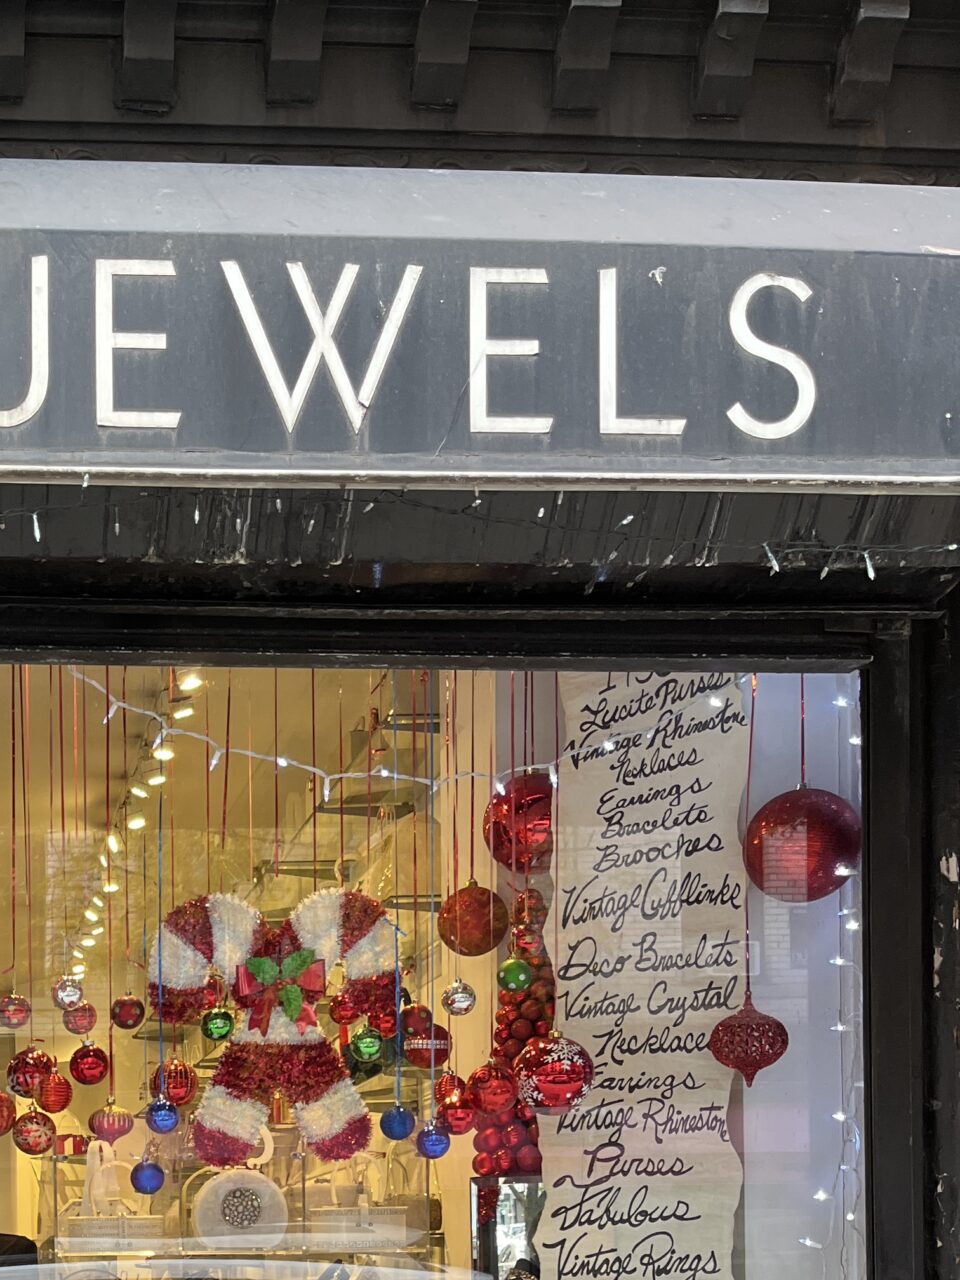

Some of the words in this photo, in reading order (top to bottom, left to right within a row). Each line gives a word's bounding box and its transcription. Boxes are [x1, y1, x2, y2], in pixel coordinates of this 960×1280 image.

[580, 690, 656, 733] Lucite
[655, 672, 733, 711] Purses
[563, 730, 642, 771] Vintage
[646, 698, 748, 750] Rhinestone
[610, 747, 704, 785] Necklaces
[597, 778, 713, 817] Earrings
[601, 802, 714, 839] Bracelets
[593, 833, 723, 872] Brooches
[562, 875, 641, 933] Vintage
[640, 867, 742, 921] Cufflinks
[557, 936, 632, 981] Deco
[632, 929, 739, 972] Bracelets
[557, 982, 641, 1027] Vintage
[647, 975, 740, 1028] Crystal
[556, 1098, 638, 1144] Vintage
[583, 1142, 694, 1178] Purses
[551, 1175, 701, 1231] Fabulous
